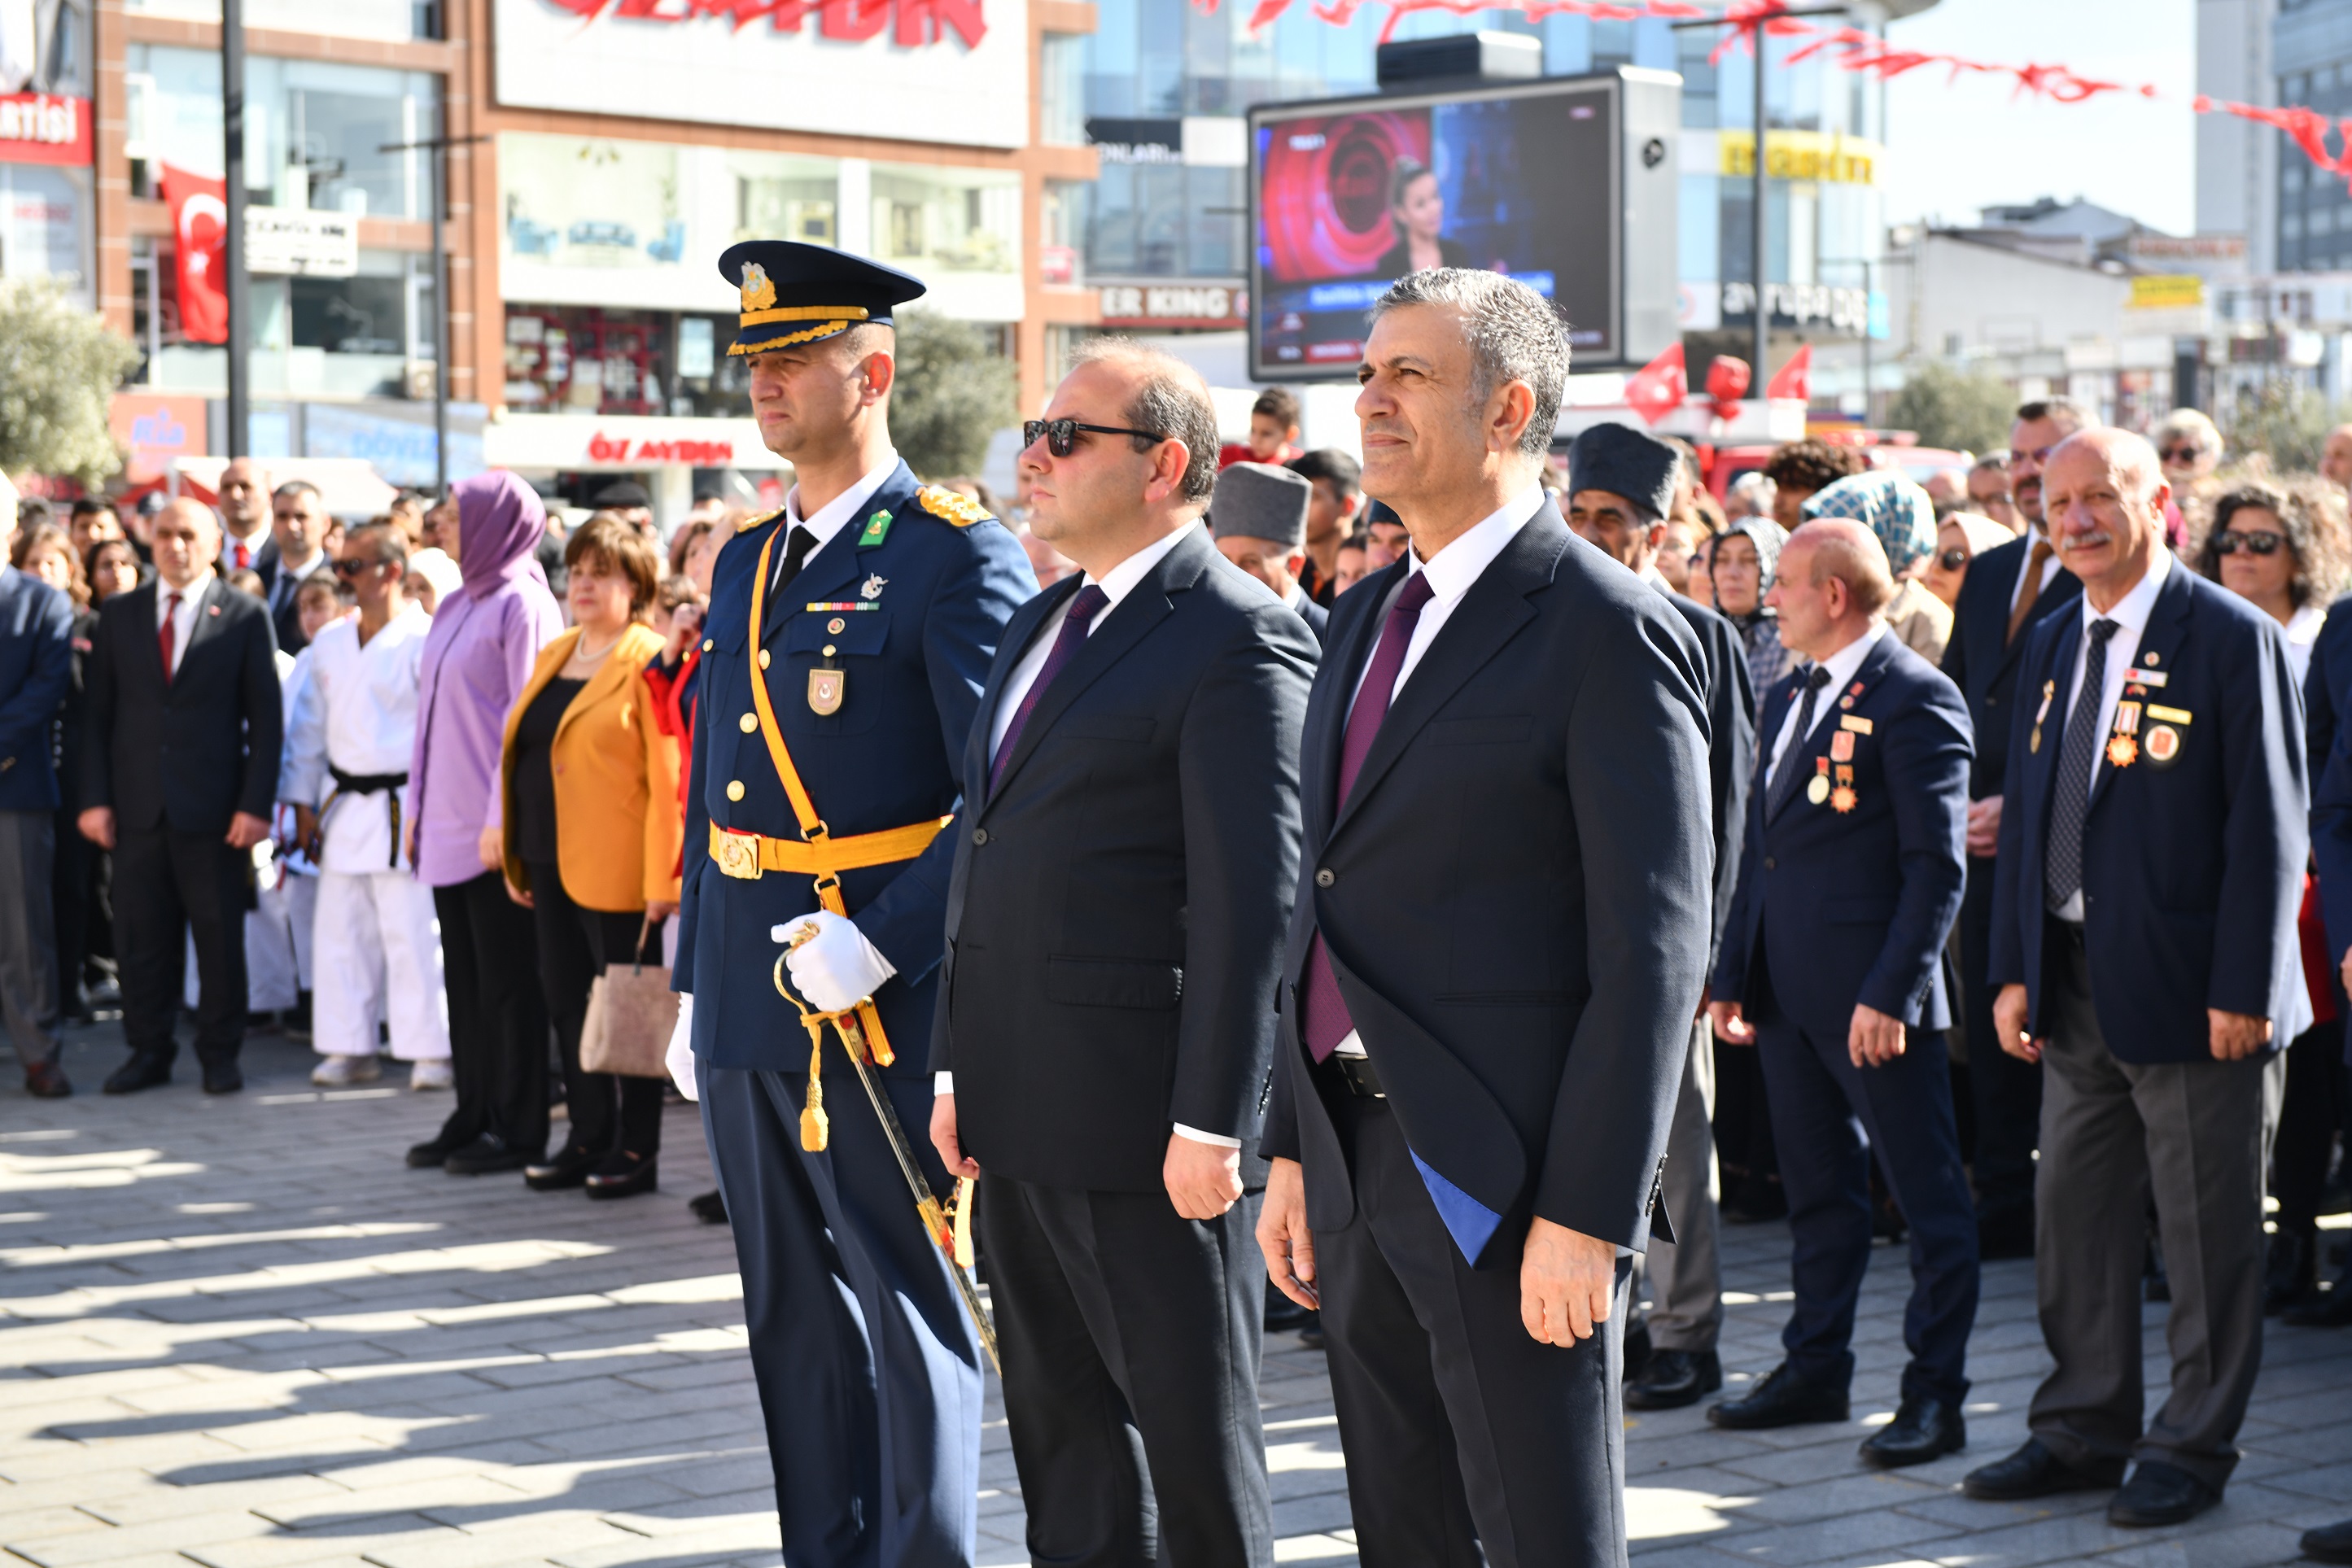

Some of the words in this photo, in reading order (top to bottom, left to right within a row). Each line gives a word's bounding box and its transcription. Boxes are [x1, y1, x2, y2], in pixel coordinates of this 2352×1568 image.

[0, 95, 77, 144] RTİSİ
[1102, 286, 1143, 318] ER
[1146, 287, 1230, 319] KING
[634, 439, 732, 466] AYDIN
